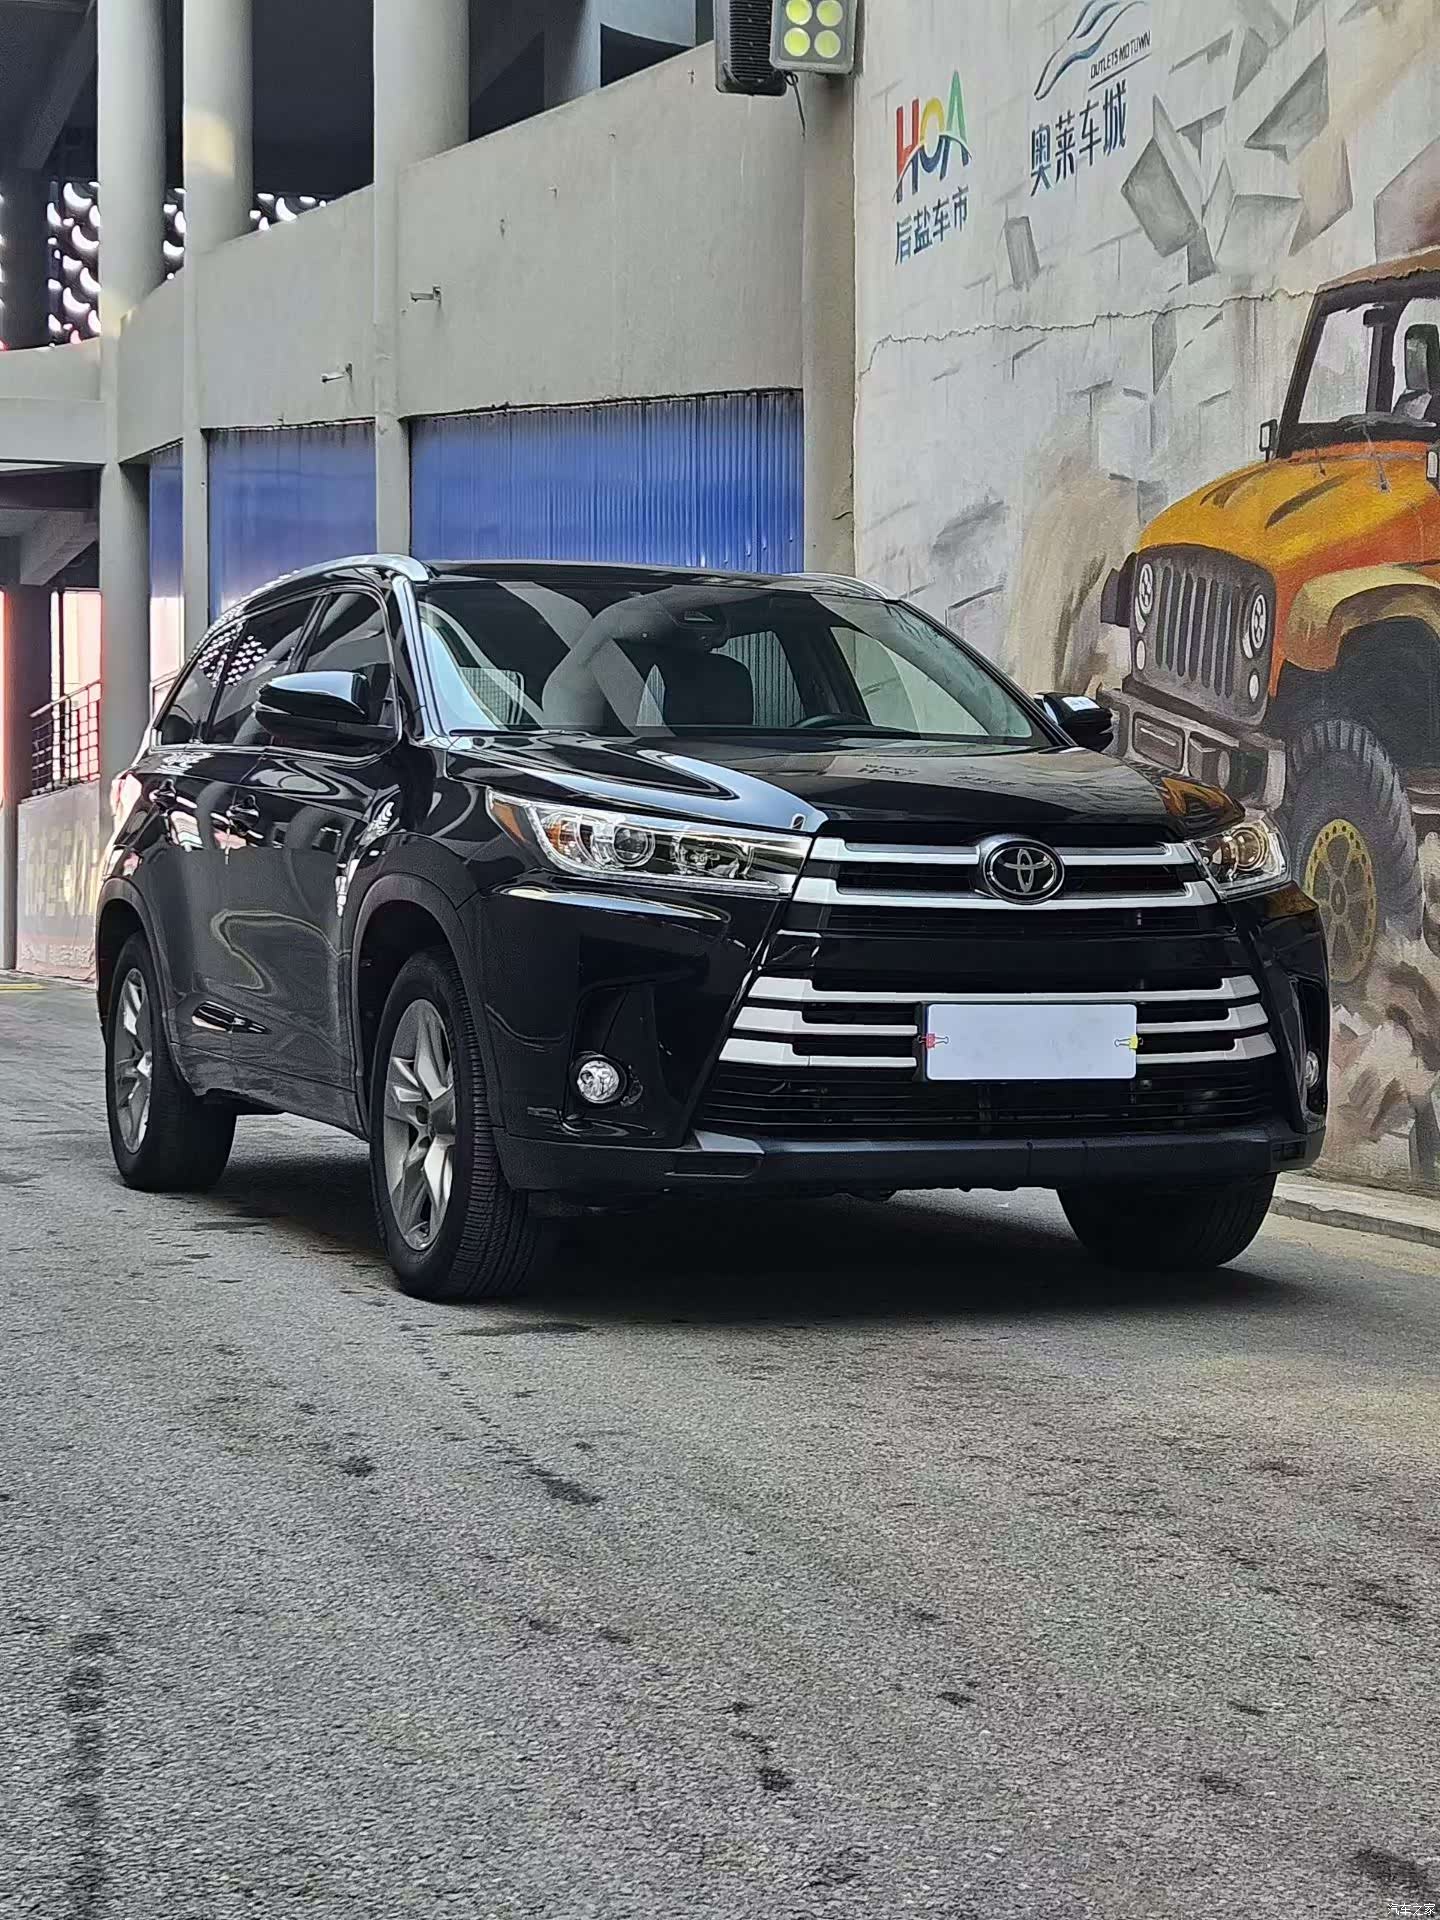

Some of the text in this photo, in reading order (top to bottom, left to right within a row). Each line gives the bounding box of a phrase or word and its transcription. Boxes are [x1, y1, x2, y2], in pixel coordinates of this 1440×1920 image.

[1090, 48, 1119, 79] OUTLETS
[1031, 79, 1127, 197] 奥莱车城
[895, 185, 969, 266] 后盐车市
